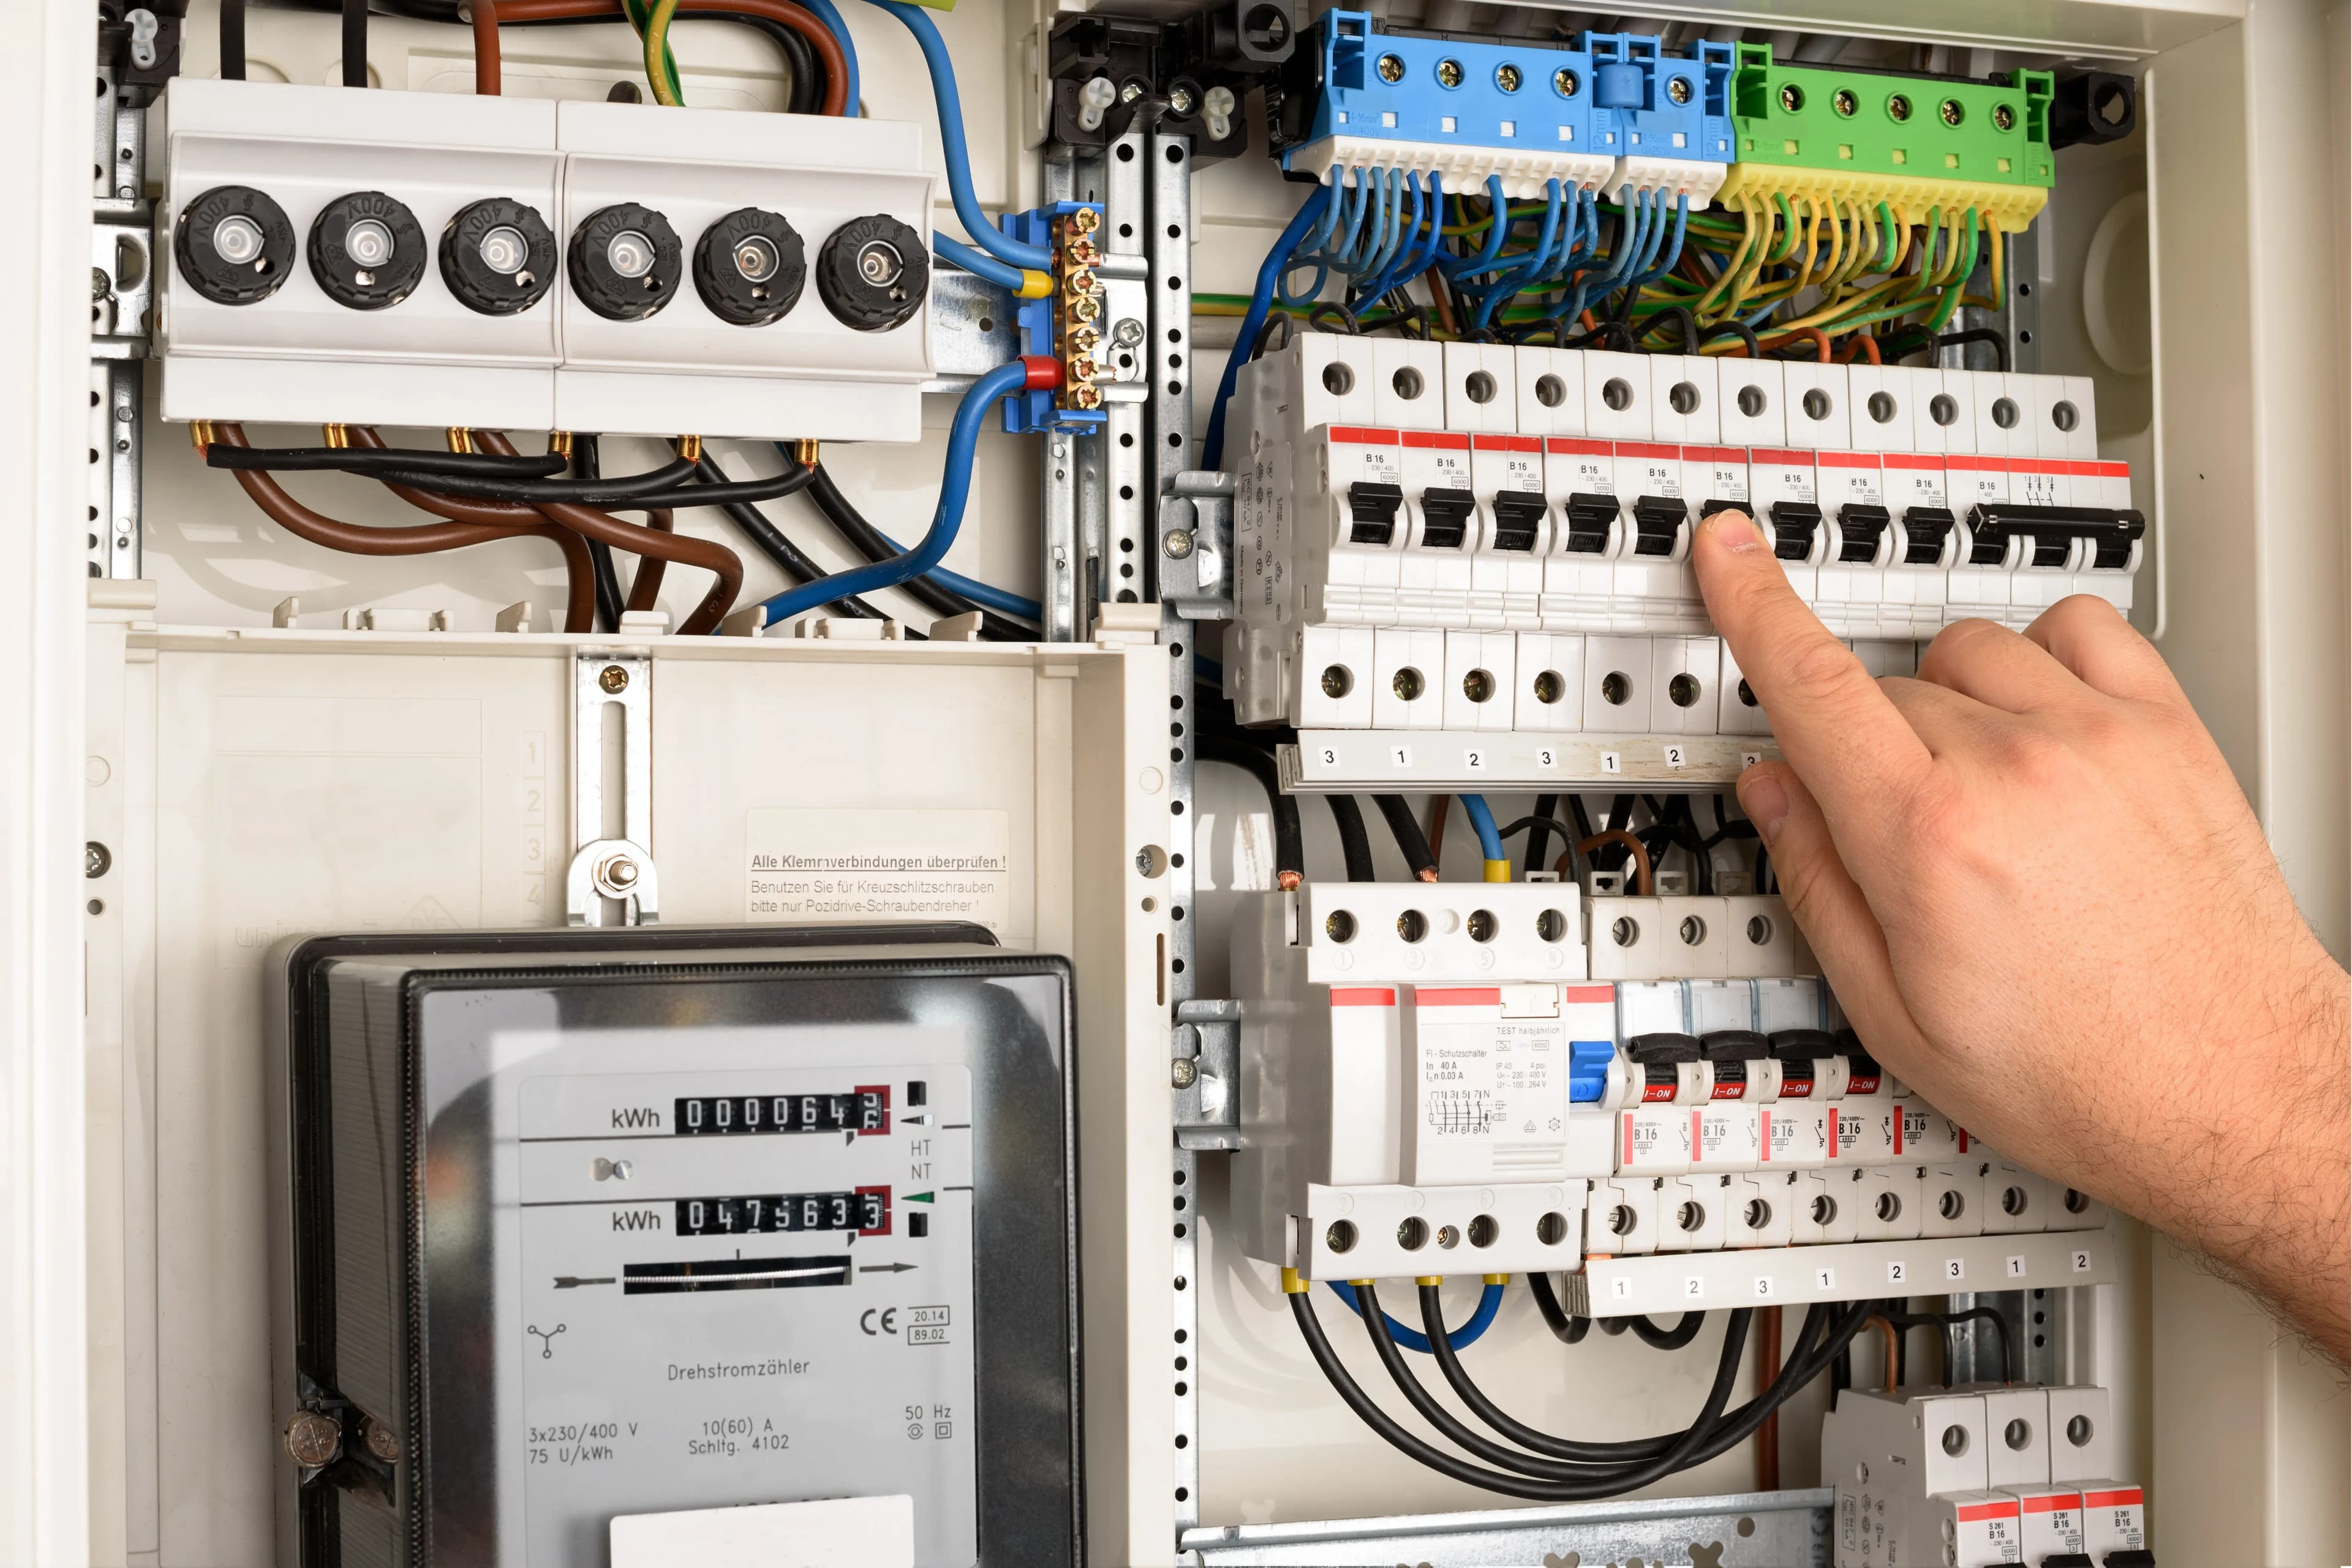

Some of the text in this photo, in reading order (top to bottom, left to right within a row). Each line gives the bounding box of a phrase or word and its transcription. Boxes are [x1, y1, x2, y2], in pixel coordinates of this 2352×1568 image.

[347, 197, 396, 219] 400V
[463, 205, 502, 244] 400V
[590, 210, 630, 249] 400V
[727, 214, 773, 240] 400V
[843, 221, 881, 256] 400V
[529, 742, 535, 763] 1
[1325, 751, 1333, 763] 3
[1398, 750, 1404, 763] 1
[1470, 753, 1479, 766] 2
[1542, 752, 1551, 764] 3
[1607, 756, 1612, 769] 1
[1670, 750, 1679, 762] 2
[528, 790, 540, 812] 2
[529, 838, 540, 861] 3
[752, 855, 1006, 870] Alle Klemmverbindungen überprüfen !
[528, 883, 540, 905] 4
[752, 881, 994, 893] Benutzen Sie für Kreuzschlitzschrauben
[752, 900, 777, 912] bitte
[782, 902, 801, 911] nur
[807, 900, 971, 912] Pozidrive-Schraubendreher
[1519, 1027, 1560, 1036] halbjährlich
[1439, 1049, 1487, 1058] Schutzschalter
[612, 1109, 660, 1128] kWh
[1905, 1119, 1926, 1130] B 16
[1635, 1129, 1657, 1140] B 16
[1703, 1125, 1725, 1136] B 16
[1771, 1125, 1793, 1137] B 16
[1839, 1123, 1860, 1134] B 16
[912, 1140, 930, 1156] HT
[912, 1164, 931, 1180] NT
[613, 1210, 661, 1231] kWh
[1618, 1255, 2086, 1294] 1 2 3 1 2 3 1 2
[861, 1308, 897, 1335] CE
[915, 1311, 944, 1322] 20.14
[913, 1327, 944, 1340] 89.02
[668, 1359, 810, 1381] Drehstromzähler
[906, 1405, 951, 1420] 50 Hz
[529, 1423, 637, 1444] 3x230/400 V
[703, 1417, 772, 1439] 10(60) A
[689, 1434, 789, 1456] Schltg. 4102
[530, 1445, 612, 1465] 75 U/kWh
